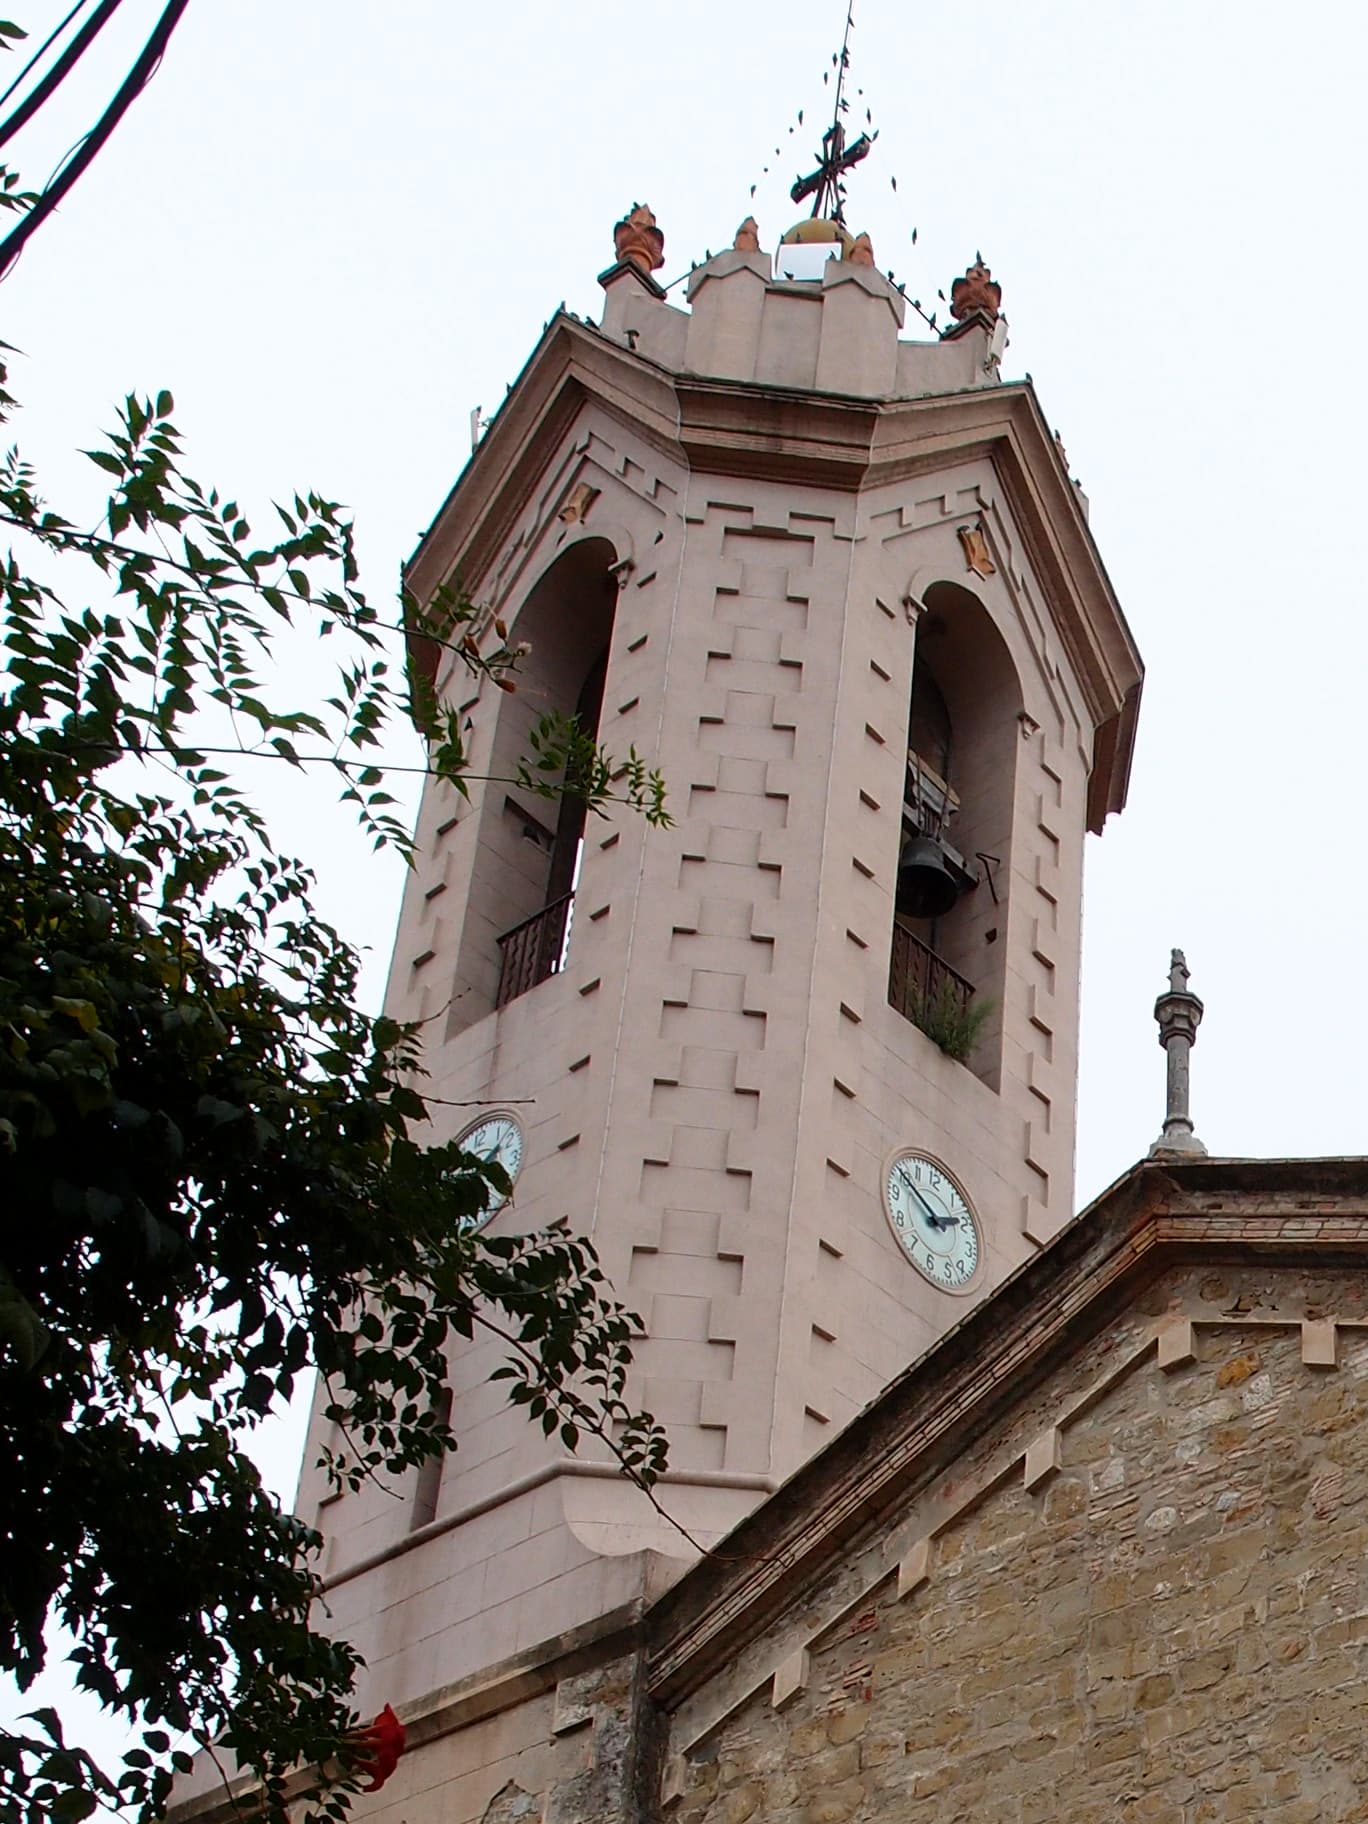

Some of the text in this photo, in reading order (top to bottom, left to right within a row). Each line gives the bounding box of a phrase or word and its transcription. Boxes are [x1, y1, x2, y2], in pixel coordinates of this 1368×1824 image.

[930, 1170, 941, 1191] 12
[892, 1184, 900, 1200] 9
[896, 1210, 904, 1227] 8
[911, 1235, 918, 1251] 7
[926, 1254, 935, 1271] 6
[944, 1262, 952, 1279] 5
